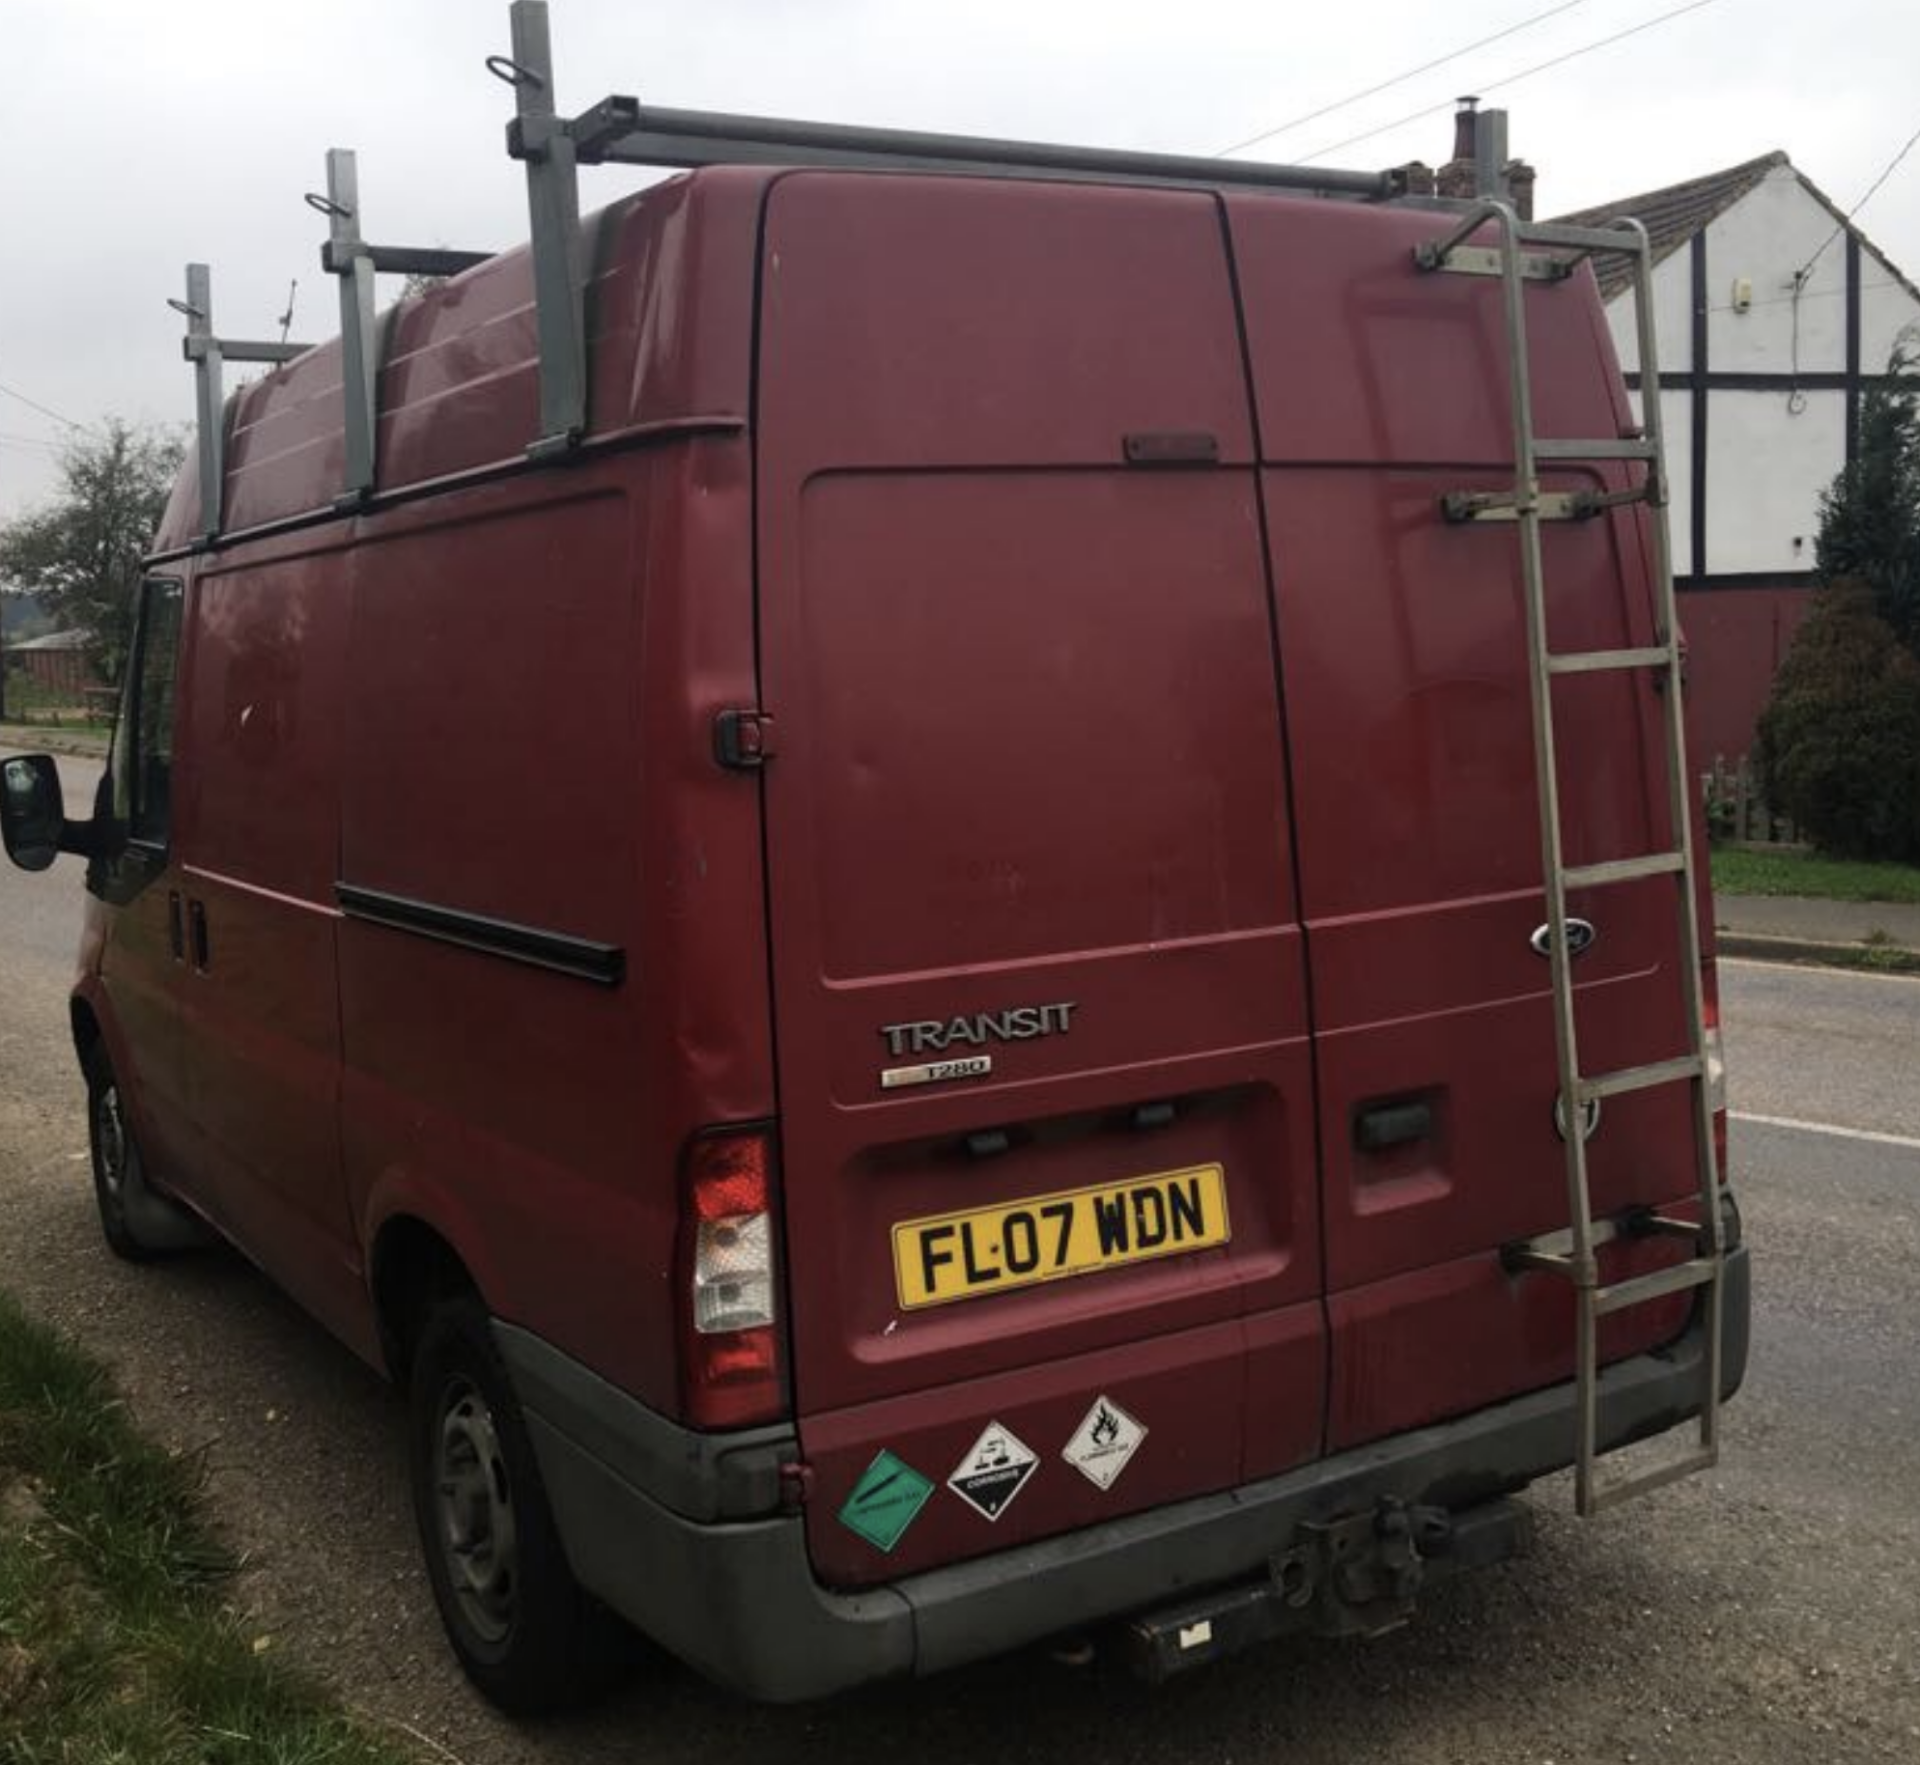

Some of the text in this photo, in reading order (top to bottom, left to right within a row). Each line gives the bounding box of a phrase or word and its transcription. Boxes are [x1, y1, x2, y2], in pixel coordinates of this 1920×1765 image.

[882, 1002, 1075, 1055] TRANSIT
[927, 1059, 986, 1080] T280
[920, 1178, 1204, 1293] FL07 WDN
